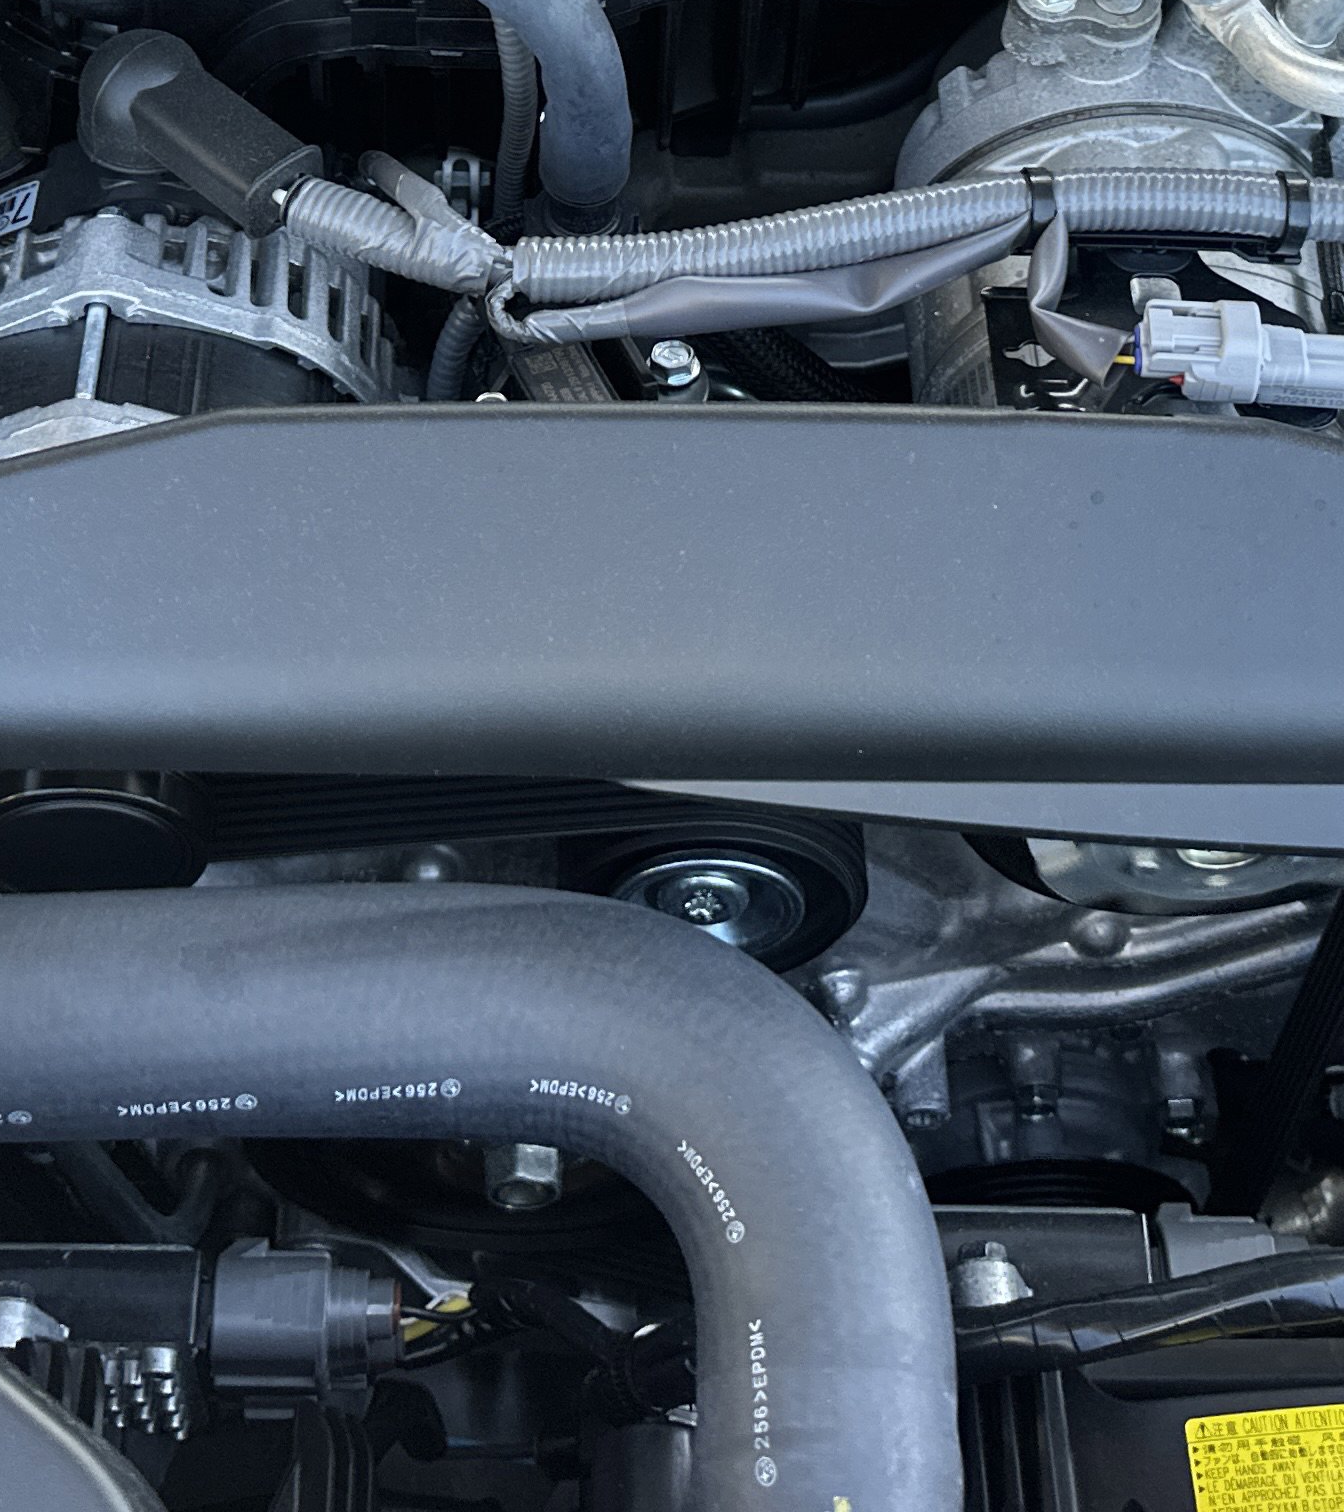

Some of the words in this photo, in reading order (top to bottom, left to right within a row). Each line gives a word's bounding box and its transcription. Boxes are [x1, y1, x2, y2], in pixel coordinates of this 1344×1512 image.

[1242, 1413, 1289, 1434] CAUTION
[1205, 1466, 1230, 1480] KEEP
[1234, 1462, 1267, 1476] HANDS
[1308, 1457, 1328, 1470] FAN
[1206, 1480, 1219, 1494] LE
[1223, 1475, 1277, 1492] DÉMARRAGE
[1282, 1473, 1296, 1486] DU
[1241, 1487, 1299, 1503] APPROCHEZ
[1305, 1484, 1326, 1497] PAS
[1301, 1499, 1309, 1512] В
